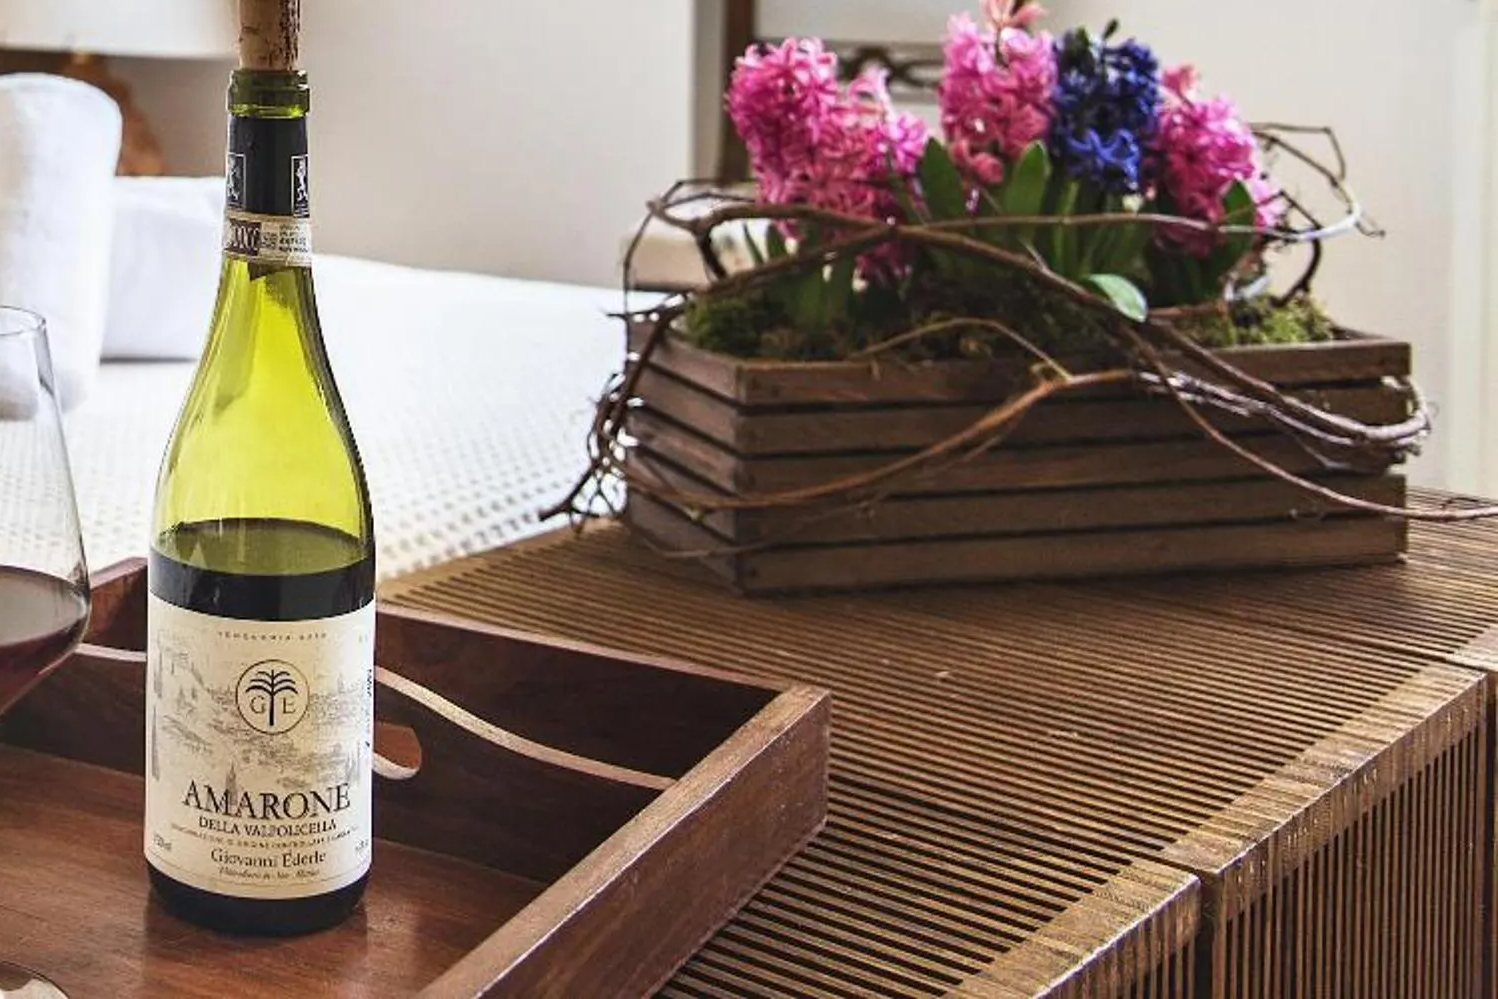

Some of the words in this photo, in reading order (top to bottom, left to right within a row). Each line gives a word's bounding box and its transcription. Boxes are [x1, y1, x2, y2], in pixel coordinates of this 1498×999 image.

[250, 695, 266, 715] G
[282, 695, 296, 715] E
[182, 779, 351, 821] AMARONE
[198, 815, 240, 837] DELLA
[210, 847, 278, 869] Giovanni
